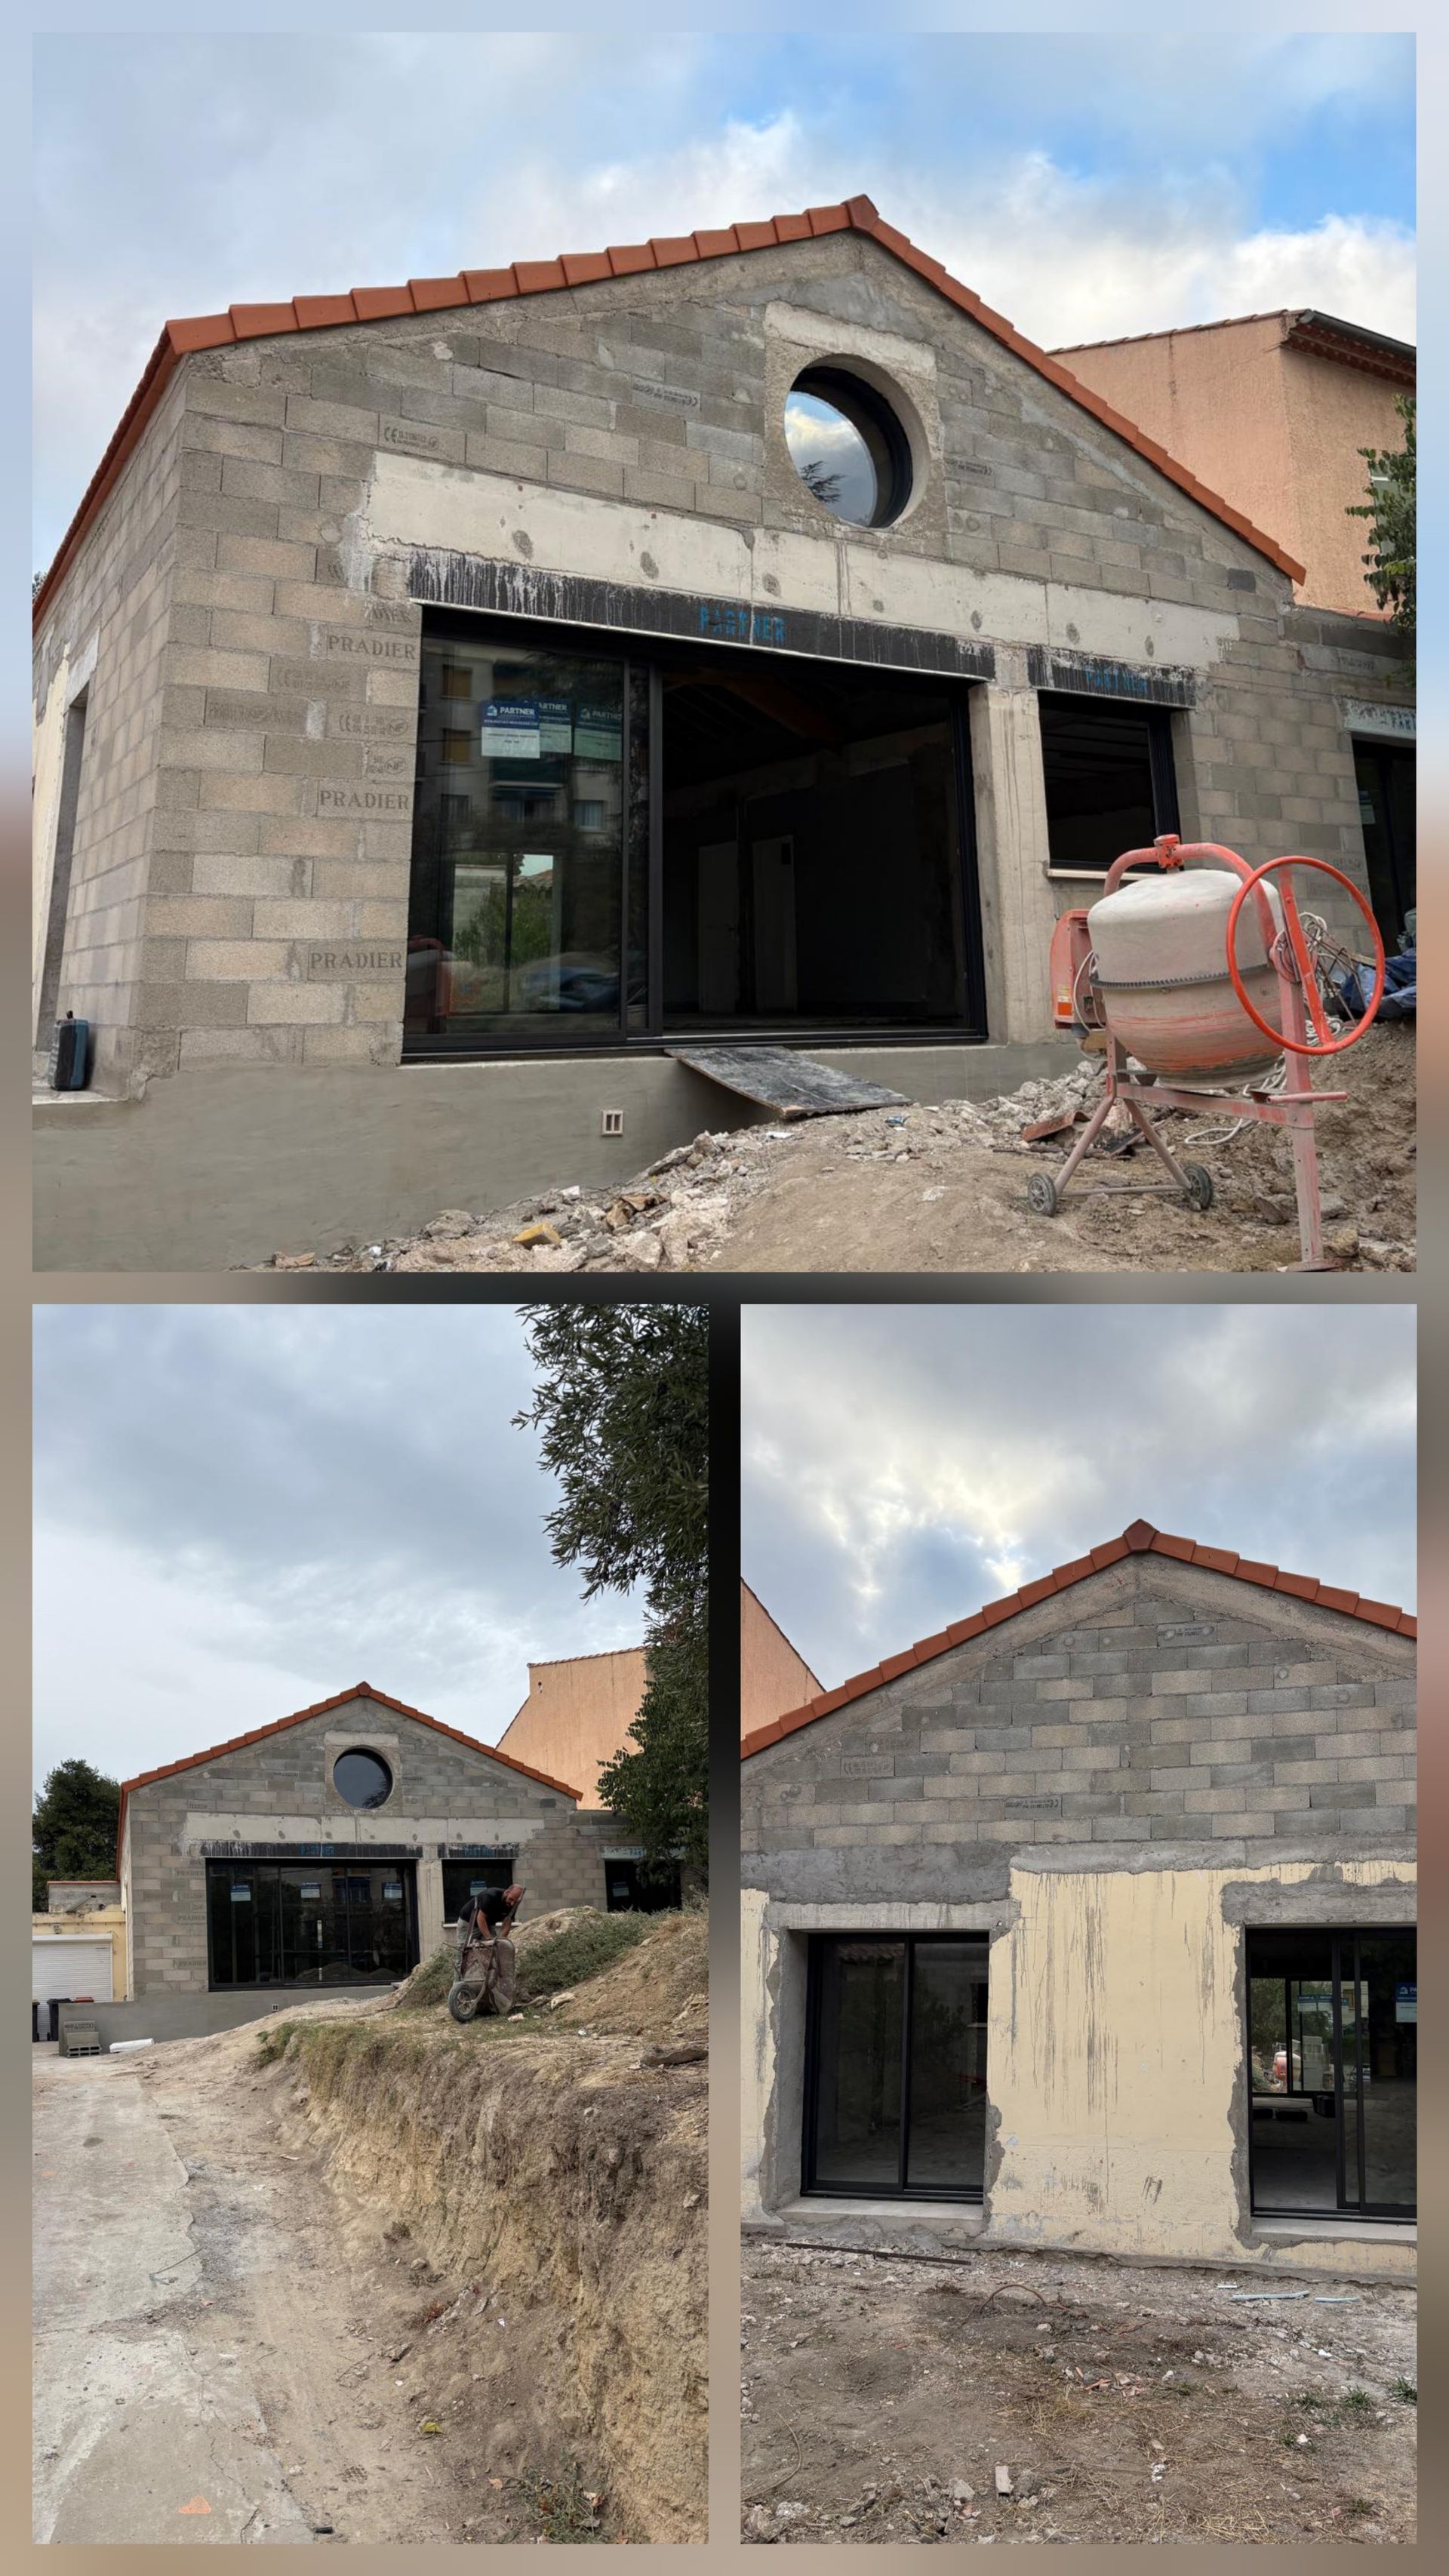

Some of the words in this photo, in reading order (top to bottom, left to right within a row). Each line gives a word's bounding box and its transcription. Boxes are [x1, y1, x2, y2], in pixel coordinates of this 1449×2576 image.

[328, 635, 415, 660] PRADIER
[500, 706, 535, 716] PARTNER
[320, 789, 409, 810] PRADIER
[310, 952, 402, 968] PRADIER
